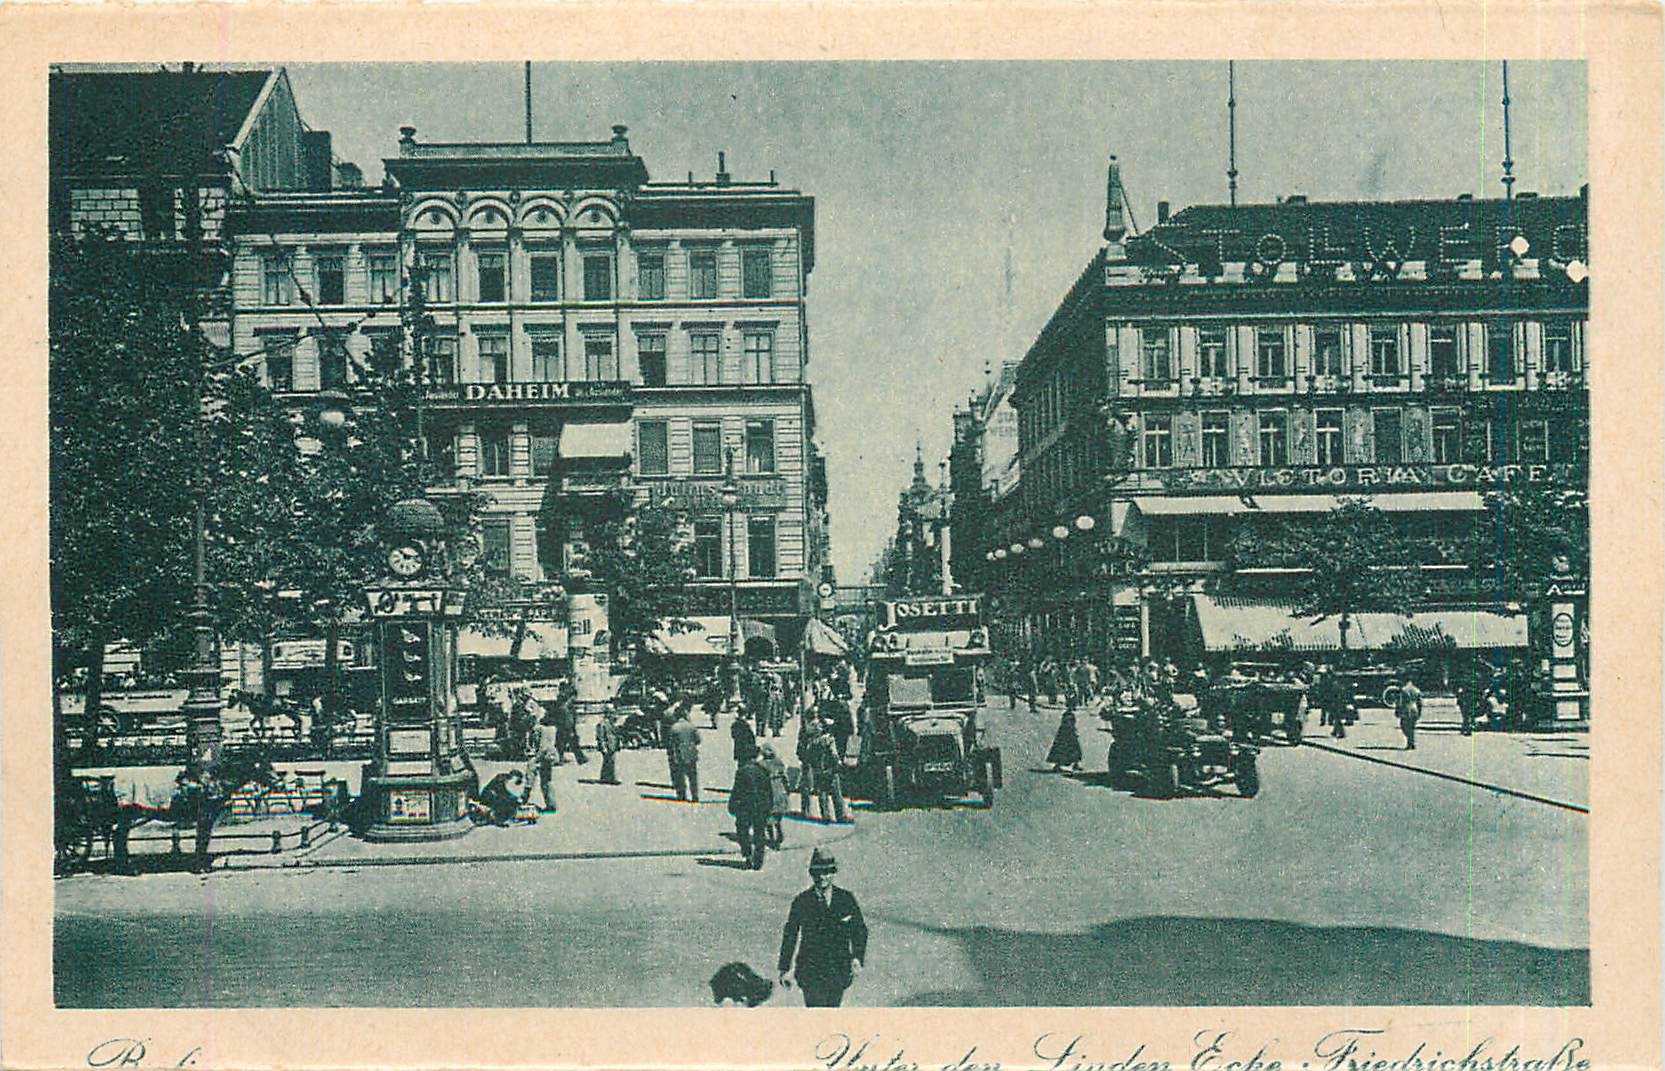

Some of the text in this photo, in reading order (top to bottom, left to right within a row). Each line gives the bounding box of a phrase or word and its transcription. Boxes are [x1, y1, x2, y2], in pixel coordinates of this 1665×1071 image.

[465, 382, 570, 400] DAHEIM
[1232, 463, 1549, 487] VICTORIA CAFE
[878, 599, 978, 631] JOSETTI
